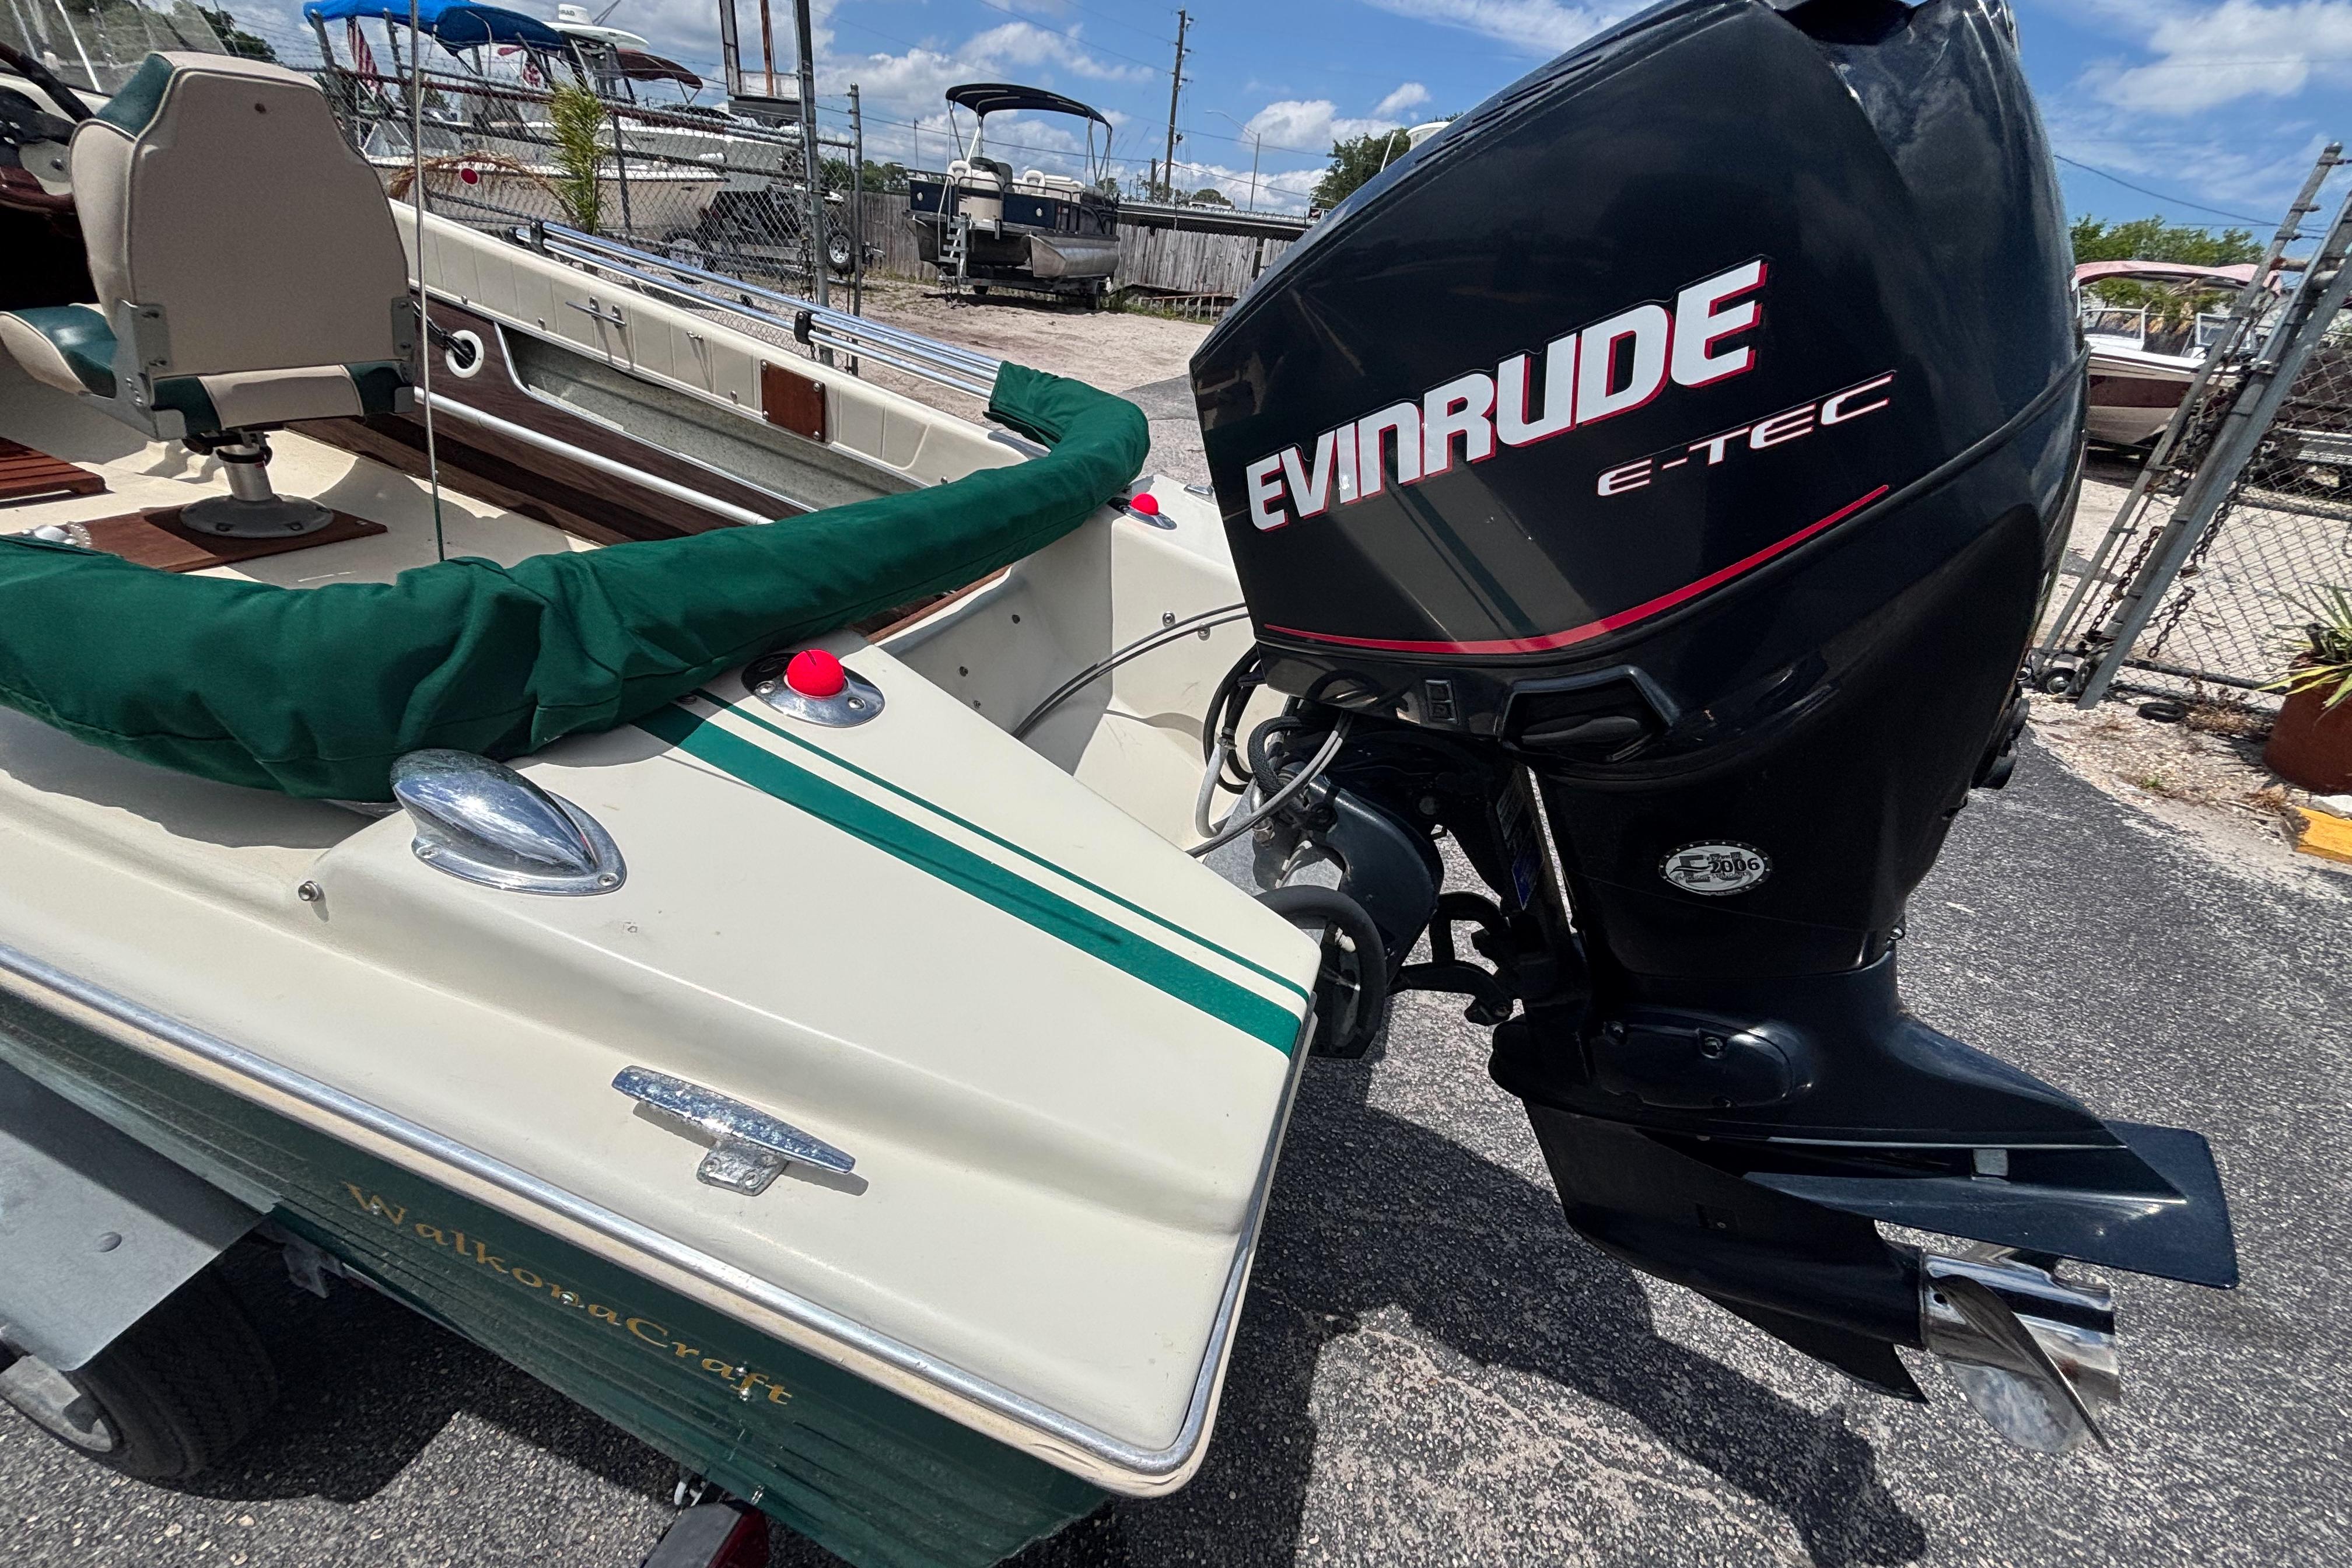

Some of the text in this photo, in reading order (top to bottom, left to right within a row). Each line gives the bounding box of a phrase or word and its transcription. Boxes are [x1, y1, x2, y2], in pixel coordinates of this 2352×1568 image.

[1247, 260, 1768, 531] EVINRUDE
[1597, 374, 1892, 497] E-TEC
[1708, 858, 1760, 874] 2006
